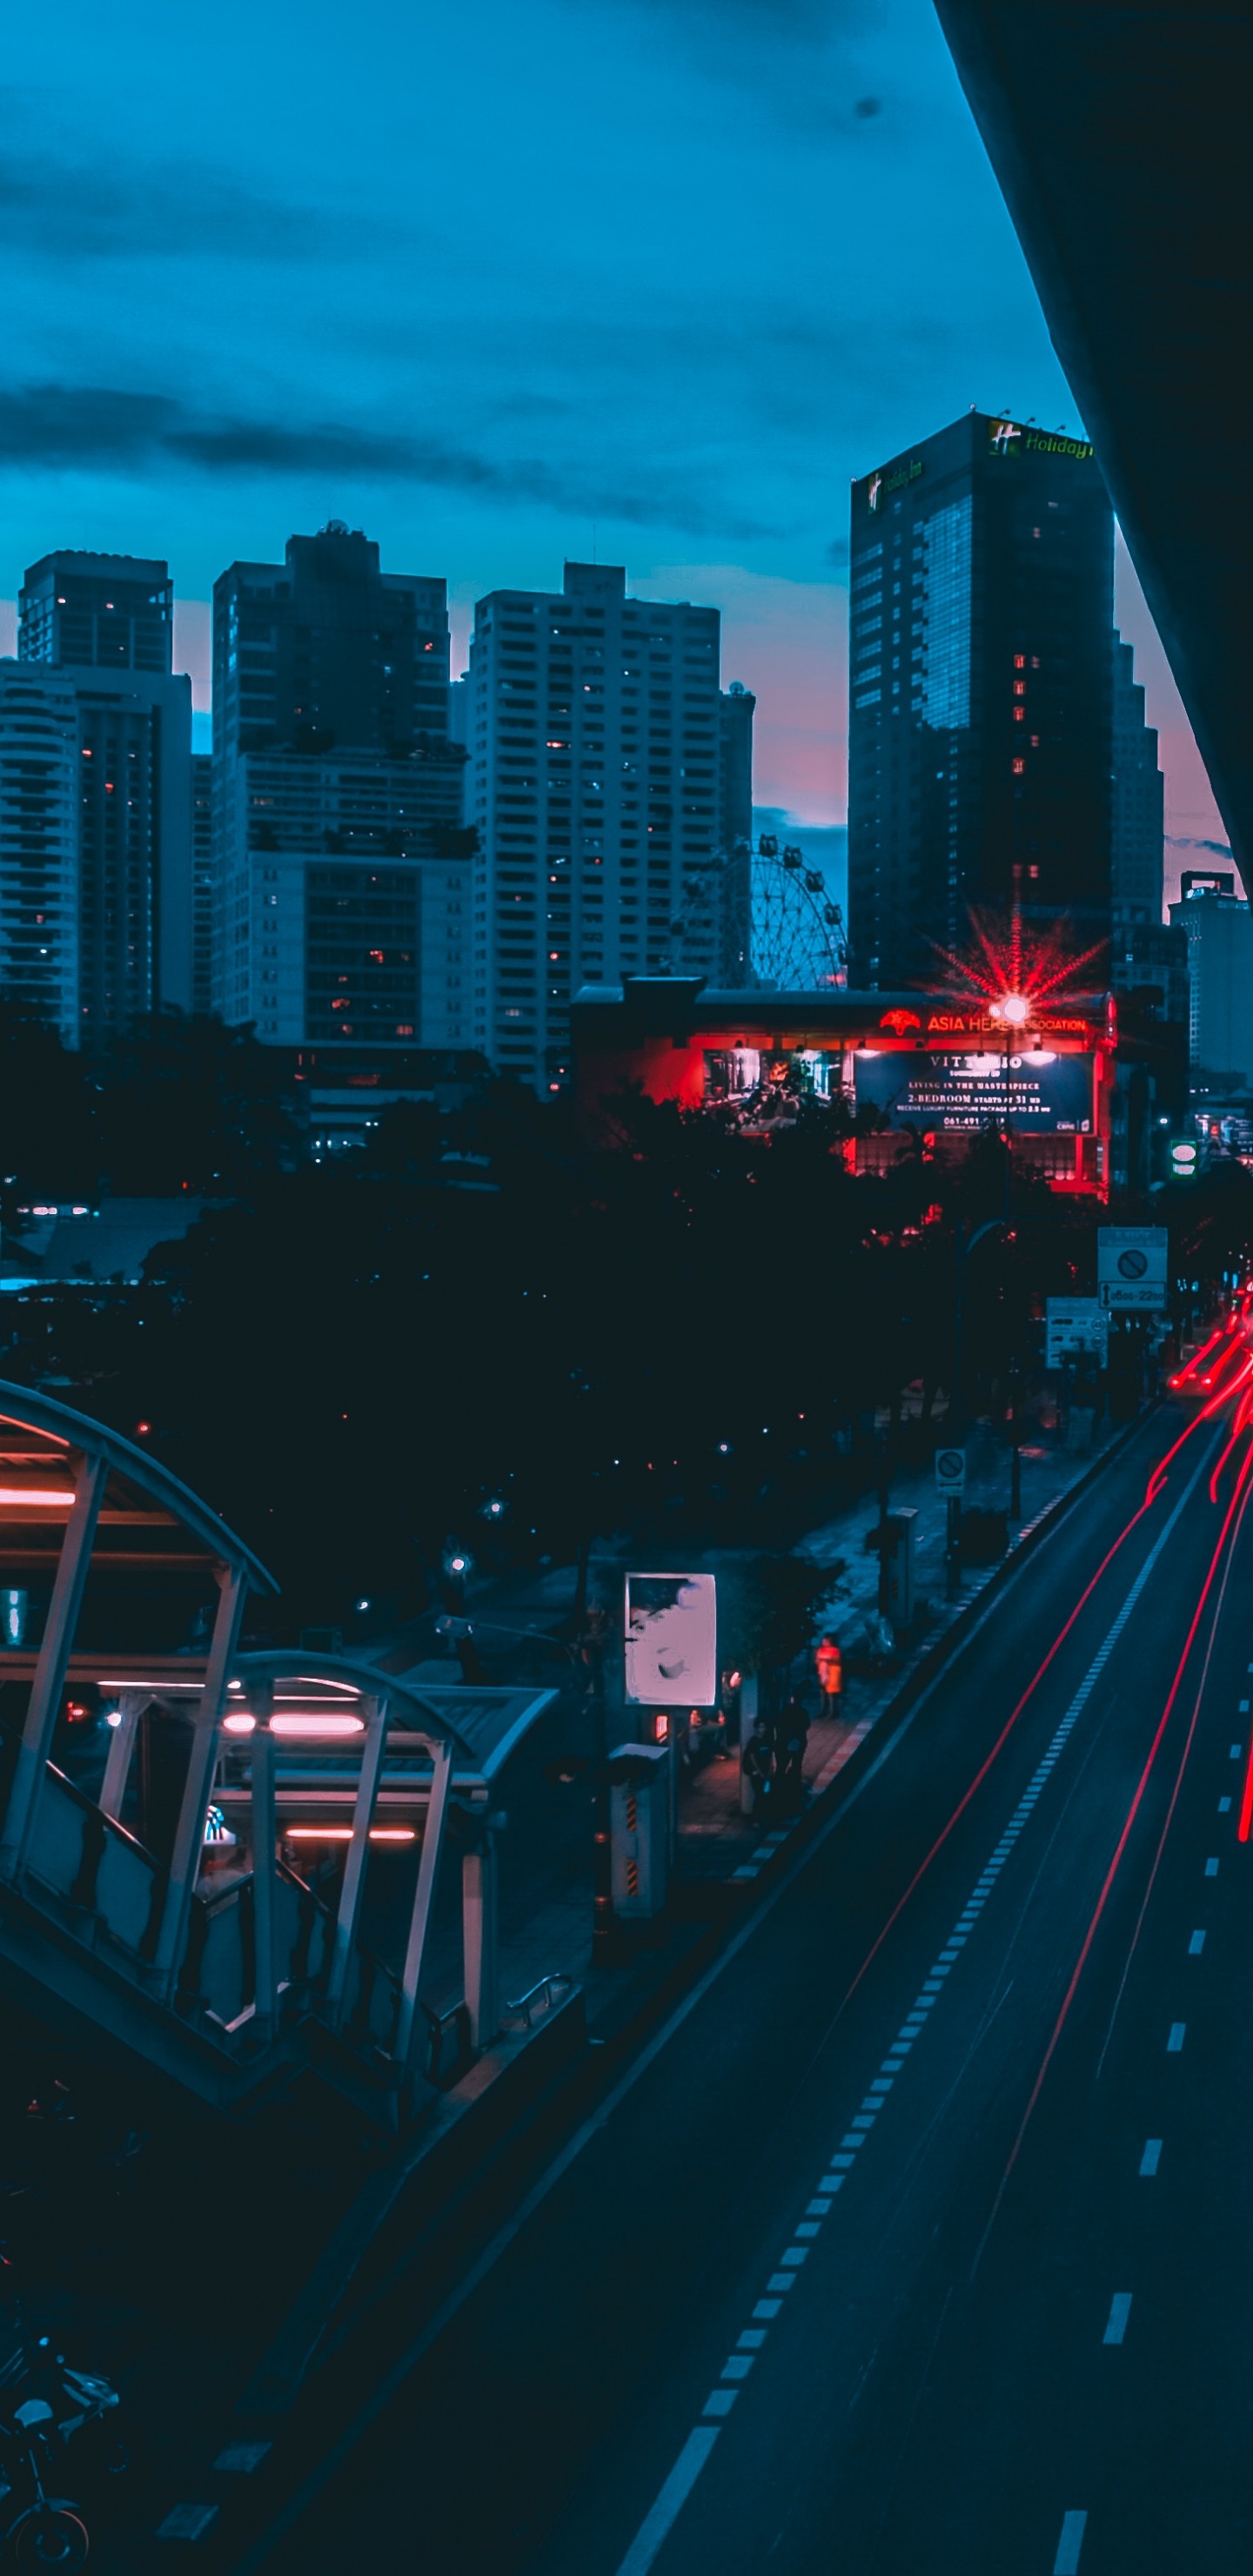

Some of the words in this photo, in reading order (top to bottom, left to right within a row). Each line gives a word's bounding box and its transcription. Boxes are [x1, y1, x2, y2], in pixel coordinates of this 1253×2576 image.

[1026, 432, 1088, 460] Holiday
[928, 1016, 965, 1031] ASIA
[1016, 1019, 1087, 1031] SSOCIATION
[930, 1056, 1022, 1070] VITIO
[908, 1094, 971, 1104] 2-BEDROOM
